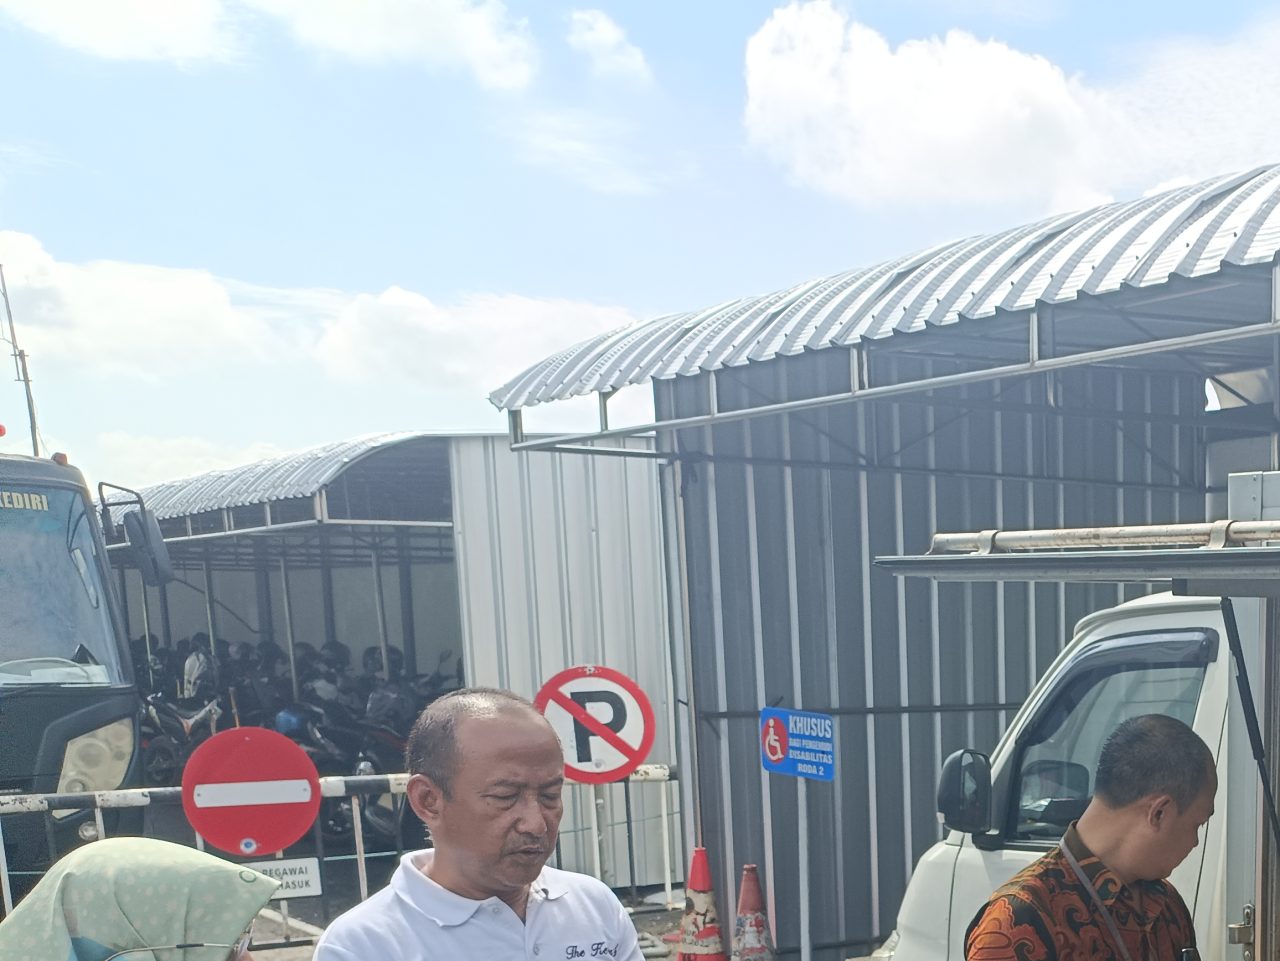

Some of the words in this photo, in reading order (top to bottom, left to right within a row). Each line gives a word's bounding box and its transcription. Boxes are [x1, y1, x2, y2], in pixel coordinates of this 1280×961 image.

[789, 715, 832, 738] KHUSUS
[789, 749, 833, 764] DISABILITAS
[819, 766, 825, 775] 2
[566, 945, 586, 960] The
